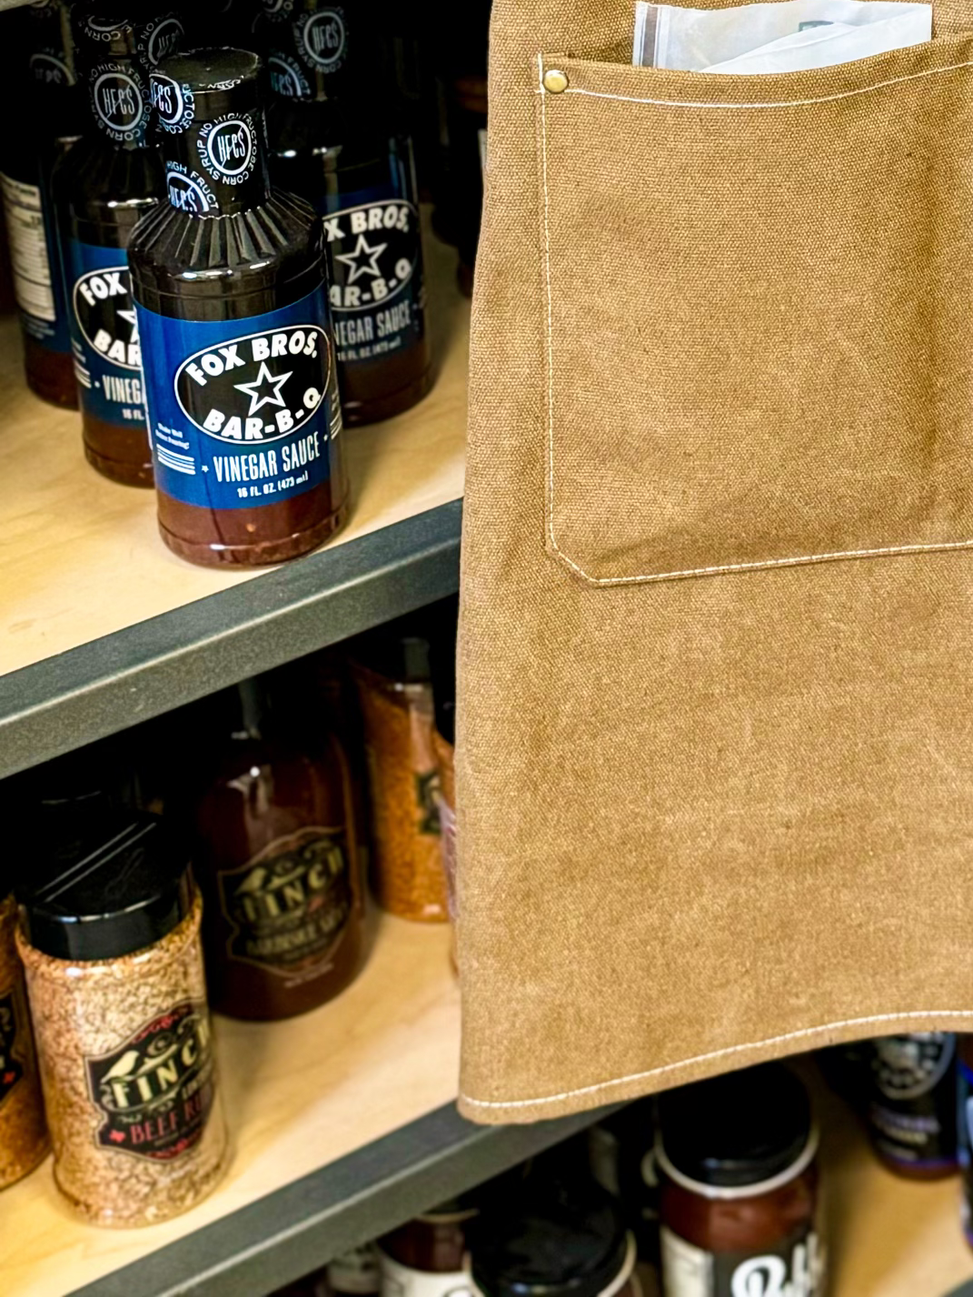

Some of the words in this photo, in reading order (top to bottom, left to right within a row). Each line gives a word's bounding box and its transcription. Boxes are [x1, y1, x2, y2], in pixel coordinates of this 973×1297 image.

[200, 123, 213, 137] NO
[196, 139, 221, 181] SYRUP
[222, 171, 249, 185] CORN
[351, 205, 409, 235] BROS.
[79, 272, 128, 307] FOX
[376, 300, 411, 337] SAUCE
[185, 344, 246, 386] FOX
[251, 331, 318, 362] BROS.
[202, 387, 321, 440] BAR-B-Q
[213, 450, 278, 483] VINEGAR
[282, 431, 320, 472] SAUCE
[237, 487, 248, 498] 16
[130, 1112, 178, 1144] BEEF
